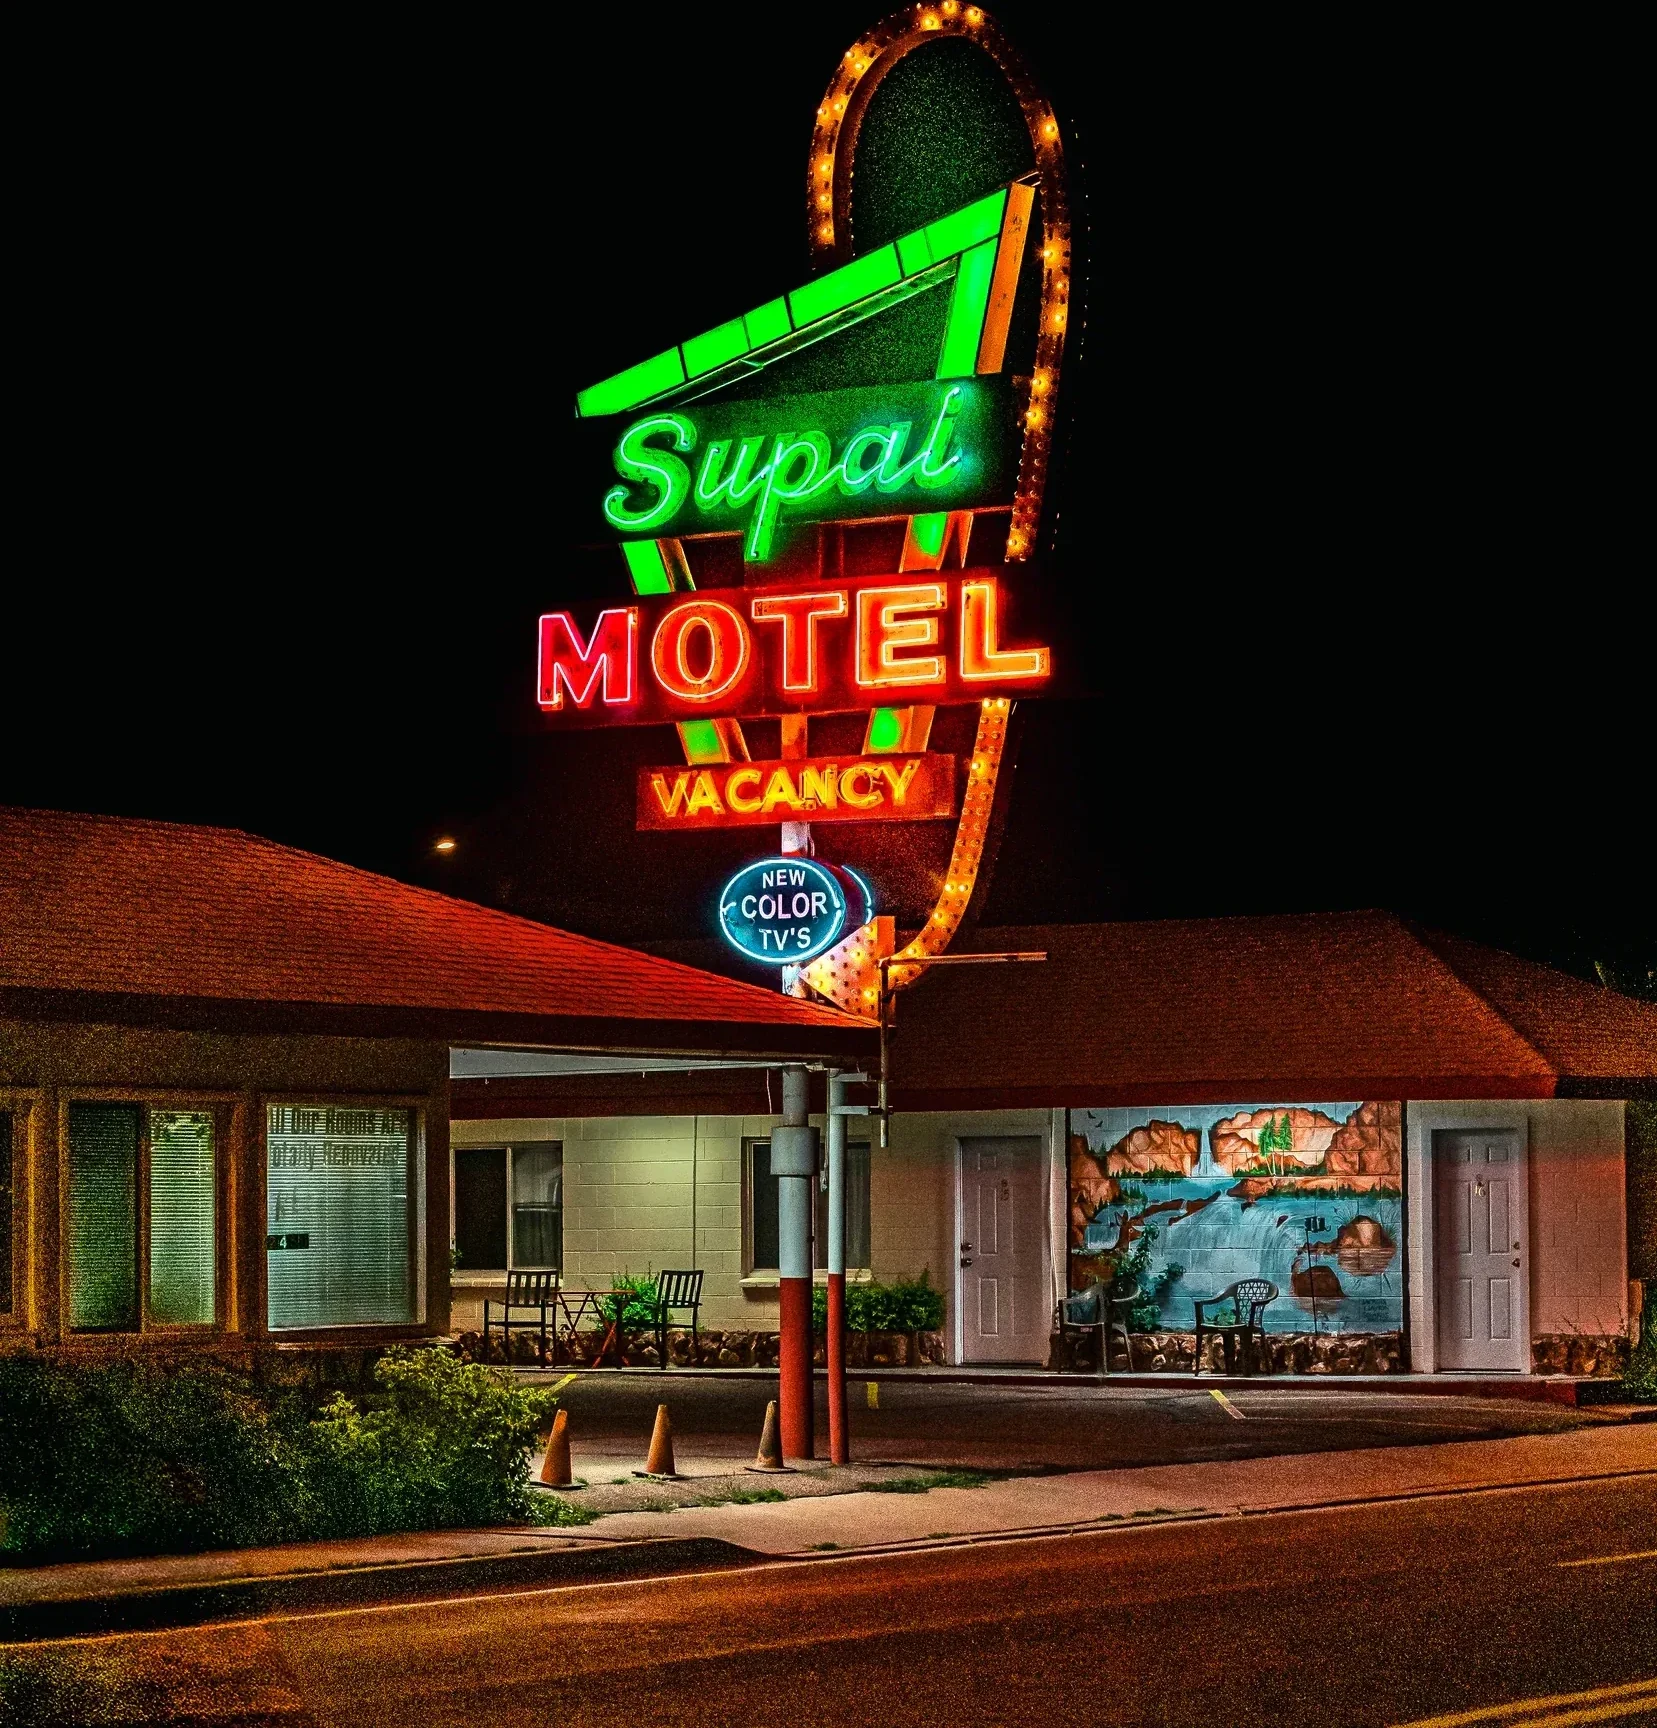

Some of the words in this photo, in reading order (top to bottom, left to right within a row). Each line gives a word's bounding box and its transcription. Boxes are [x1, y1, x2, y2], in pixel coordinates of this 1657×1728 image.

[604, 385, 966, 562] Supai
[537, 577, 1050, 711] MOTEL
[652, 759, 921, 817] VACANCY
[762, 869, 805, 889] NEW
[741, 892, 828, 919] COLOR
[759, 927, 811, 950] TV'S
